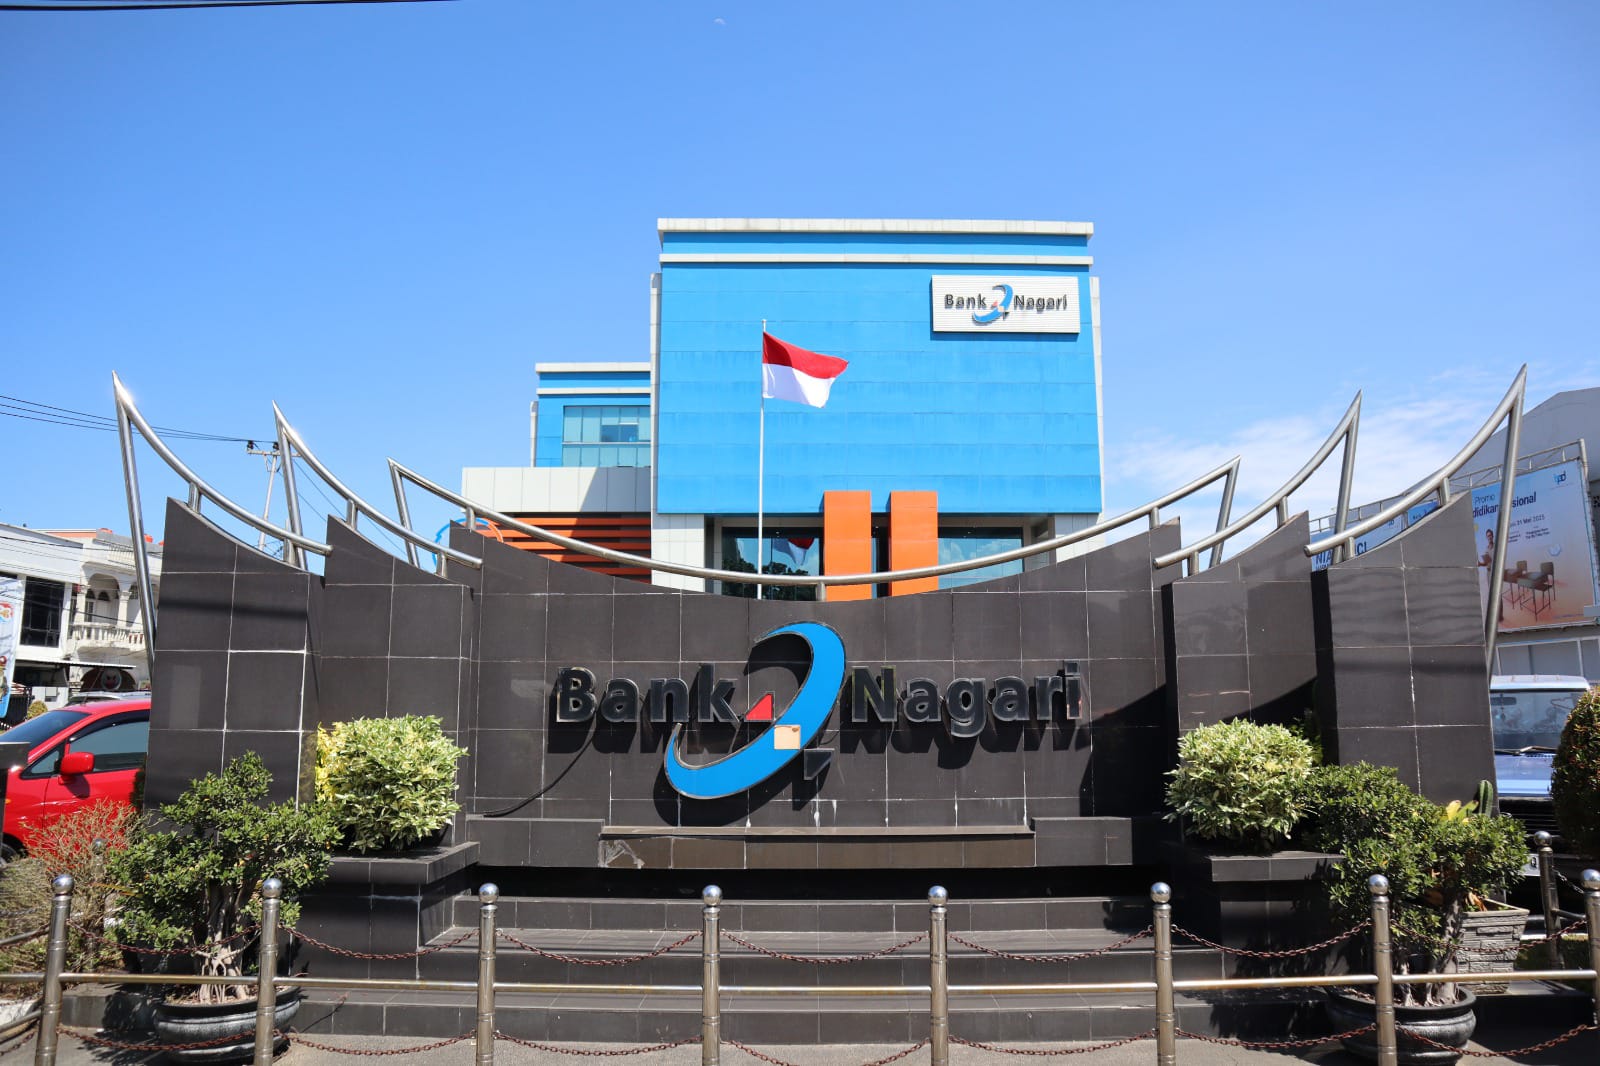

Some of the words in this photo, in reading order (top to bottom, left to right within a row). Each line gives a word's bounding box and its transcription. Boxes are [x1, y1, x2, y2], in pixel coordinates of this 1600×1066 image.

[944, 293, 986, 310] Bank
[1014, 294, 1067, 312] Nagari
[1473, 504, 1499, 518] didikan
[1512, 491, 1537, 508] sional
[1474, 493, 1496, 505] Promo
[556, 663, 740, 723] Bank
[851, 660, 1082, 738] Nagari
